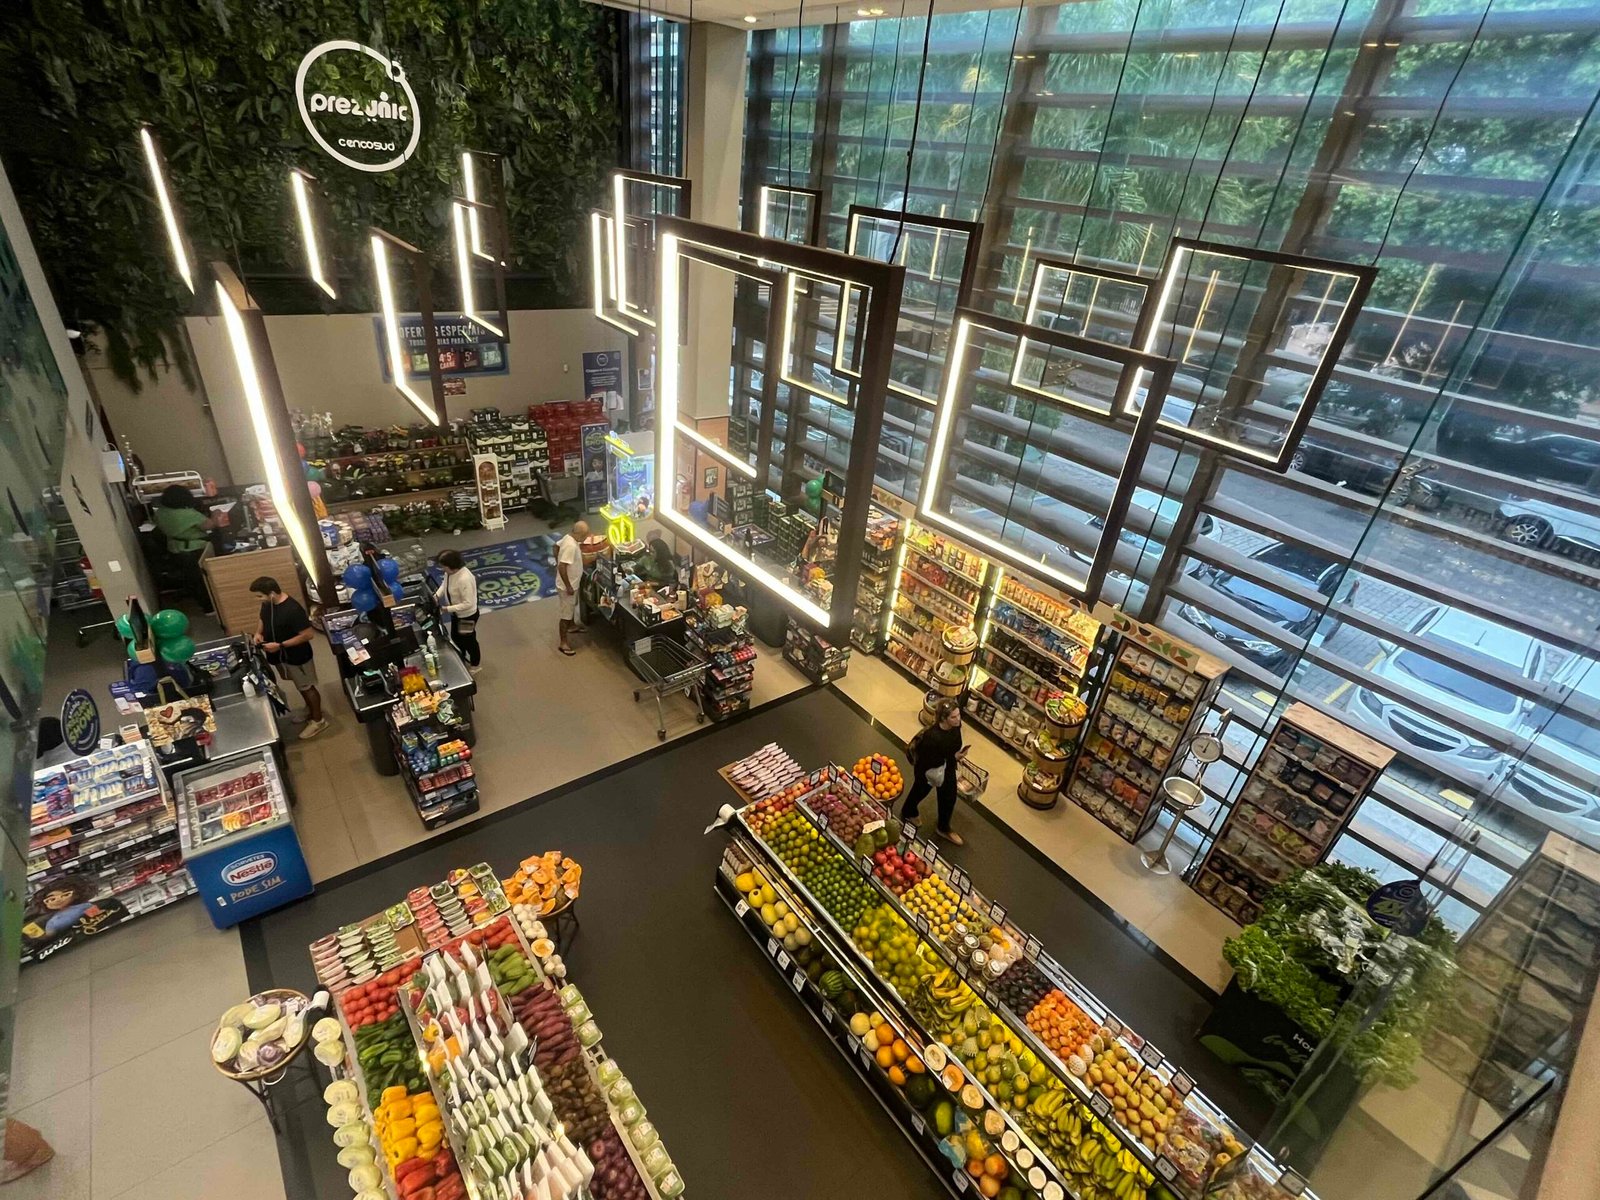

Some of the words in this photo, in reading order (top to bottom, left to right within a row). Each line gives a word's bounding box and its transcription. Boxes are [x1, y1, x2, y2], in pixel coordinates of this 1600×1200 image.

[310, 92, 408, 122] prezunic
[338, 138, 396, 152] cencosud
[230, 884, 260, 902] PODE
[261, 876, 281, 889] SIM
